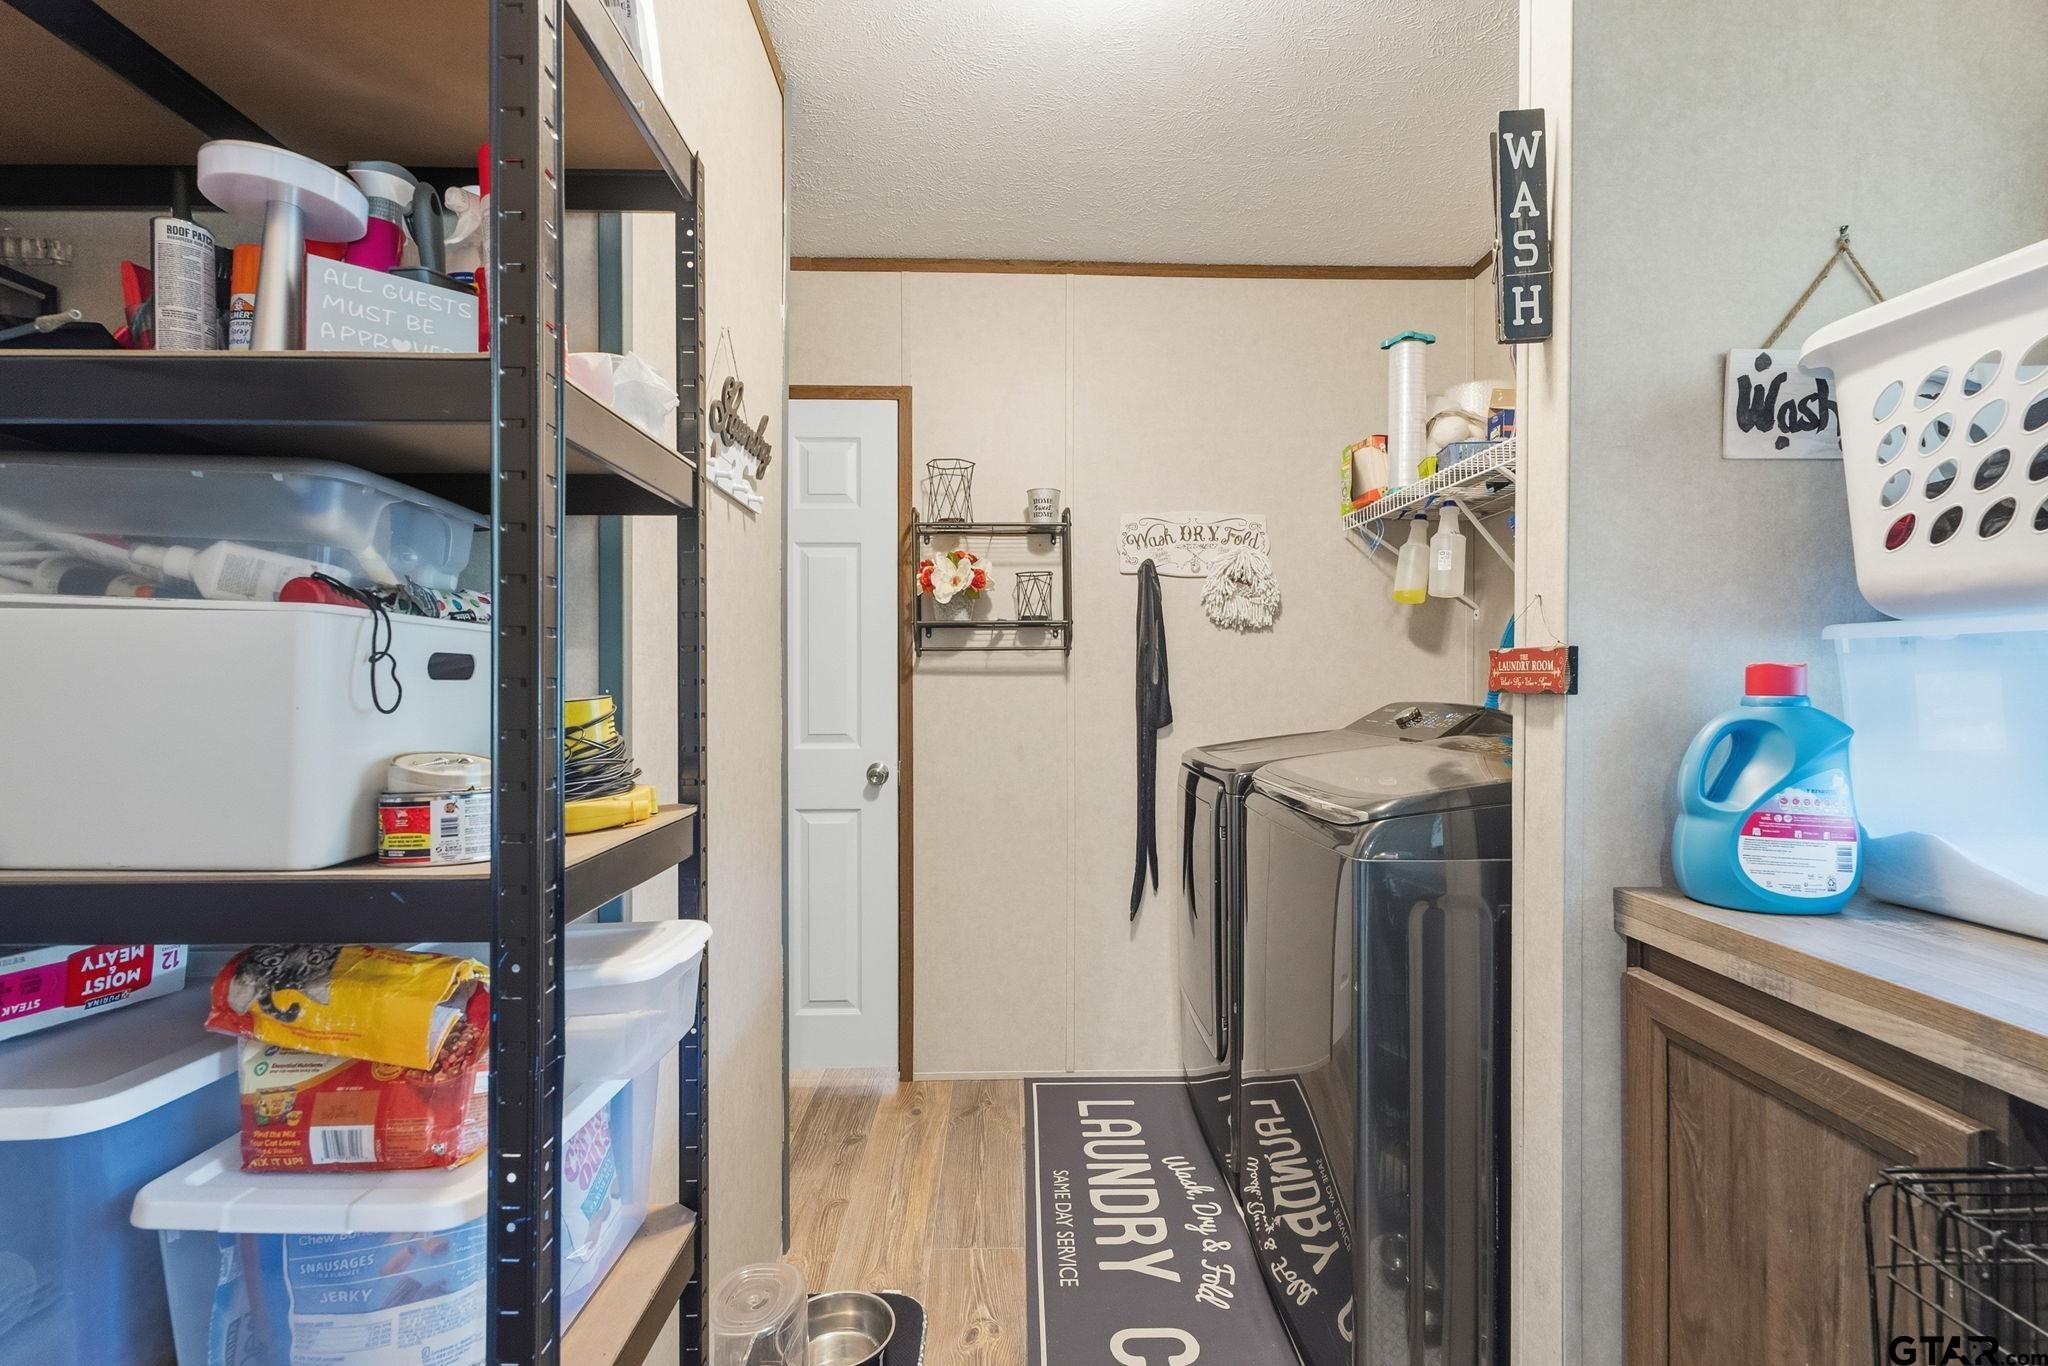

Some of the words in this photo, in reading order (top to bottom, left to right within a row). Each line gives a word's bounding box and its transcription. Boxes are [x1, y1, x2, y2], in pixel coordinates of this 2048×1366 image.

[166, 224, 191, 238] ROOF
[1503, 130, 1543, 326] WASH
[323, 268, 373, 293] ALL
[382, 283, 472, 319] GUESTS
[322, 295, 398, 326] MUST
[406, 314, 435, 335] BE
[1736, 372, 1842, 438] Wash
[1126, 523, 1177, 550] Wash
[1179, 525, 1221, 542] DRY
[1221, 527, 1261, 549] Fold
[1498, 661, 1530, 671] LAUNDRY
[1531, 660, 1554, 671] ROOM
[81, 945, 145, 973] MEATY
[109, 965, 118, 975] &
[161, 949, 180, 970] 12
[81, 967, 141, 996] MOIST
[1, 999, 41, 1017] STEAK
[87, 992, 120, 1009] PURINA
[1053, 1169, 1071, 1200] SAME
[1077, 1099, 1181, 1284] LAUNDRY
[1161, 1156, 1214, 1200] Wash,
[1055, 1202, 1074, 1228] DAY
[1184, 1202, 1224, 1236] Dry
[299, 1232, 338, 1247] Chew
[1203, 1239, 1231, 1253] &
[300, 1253, 376, 1275] SNAUSAGES
[1058, 1231, 1080, 1288] SERVICE
[319, 1288, 374, 1305] JERKY
[1195, 1259, 1236, 1310] Fold
